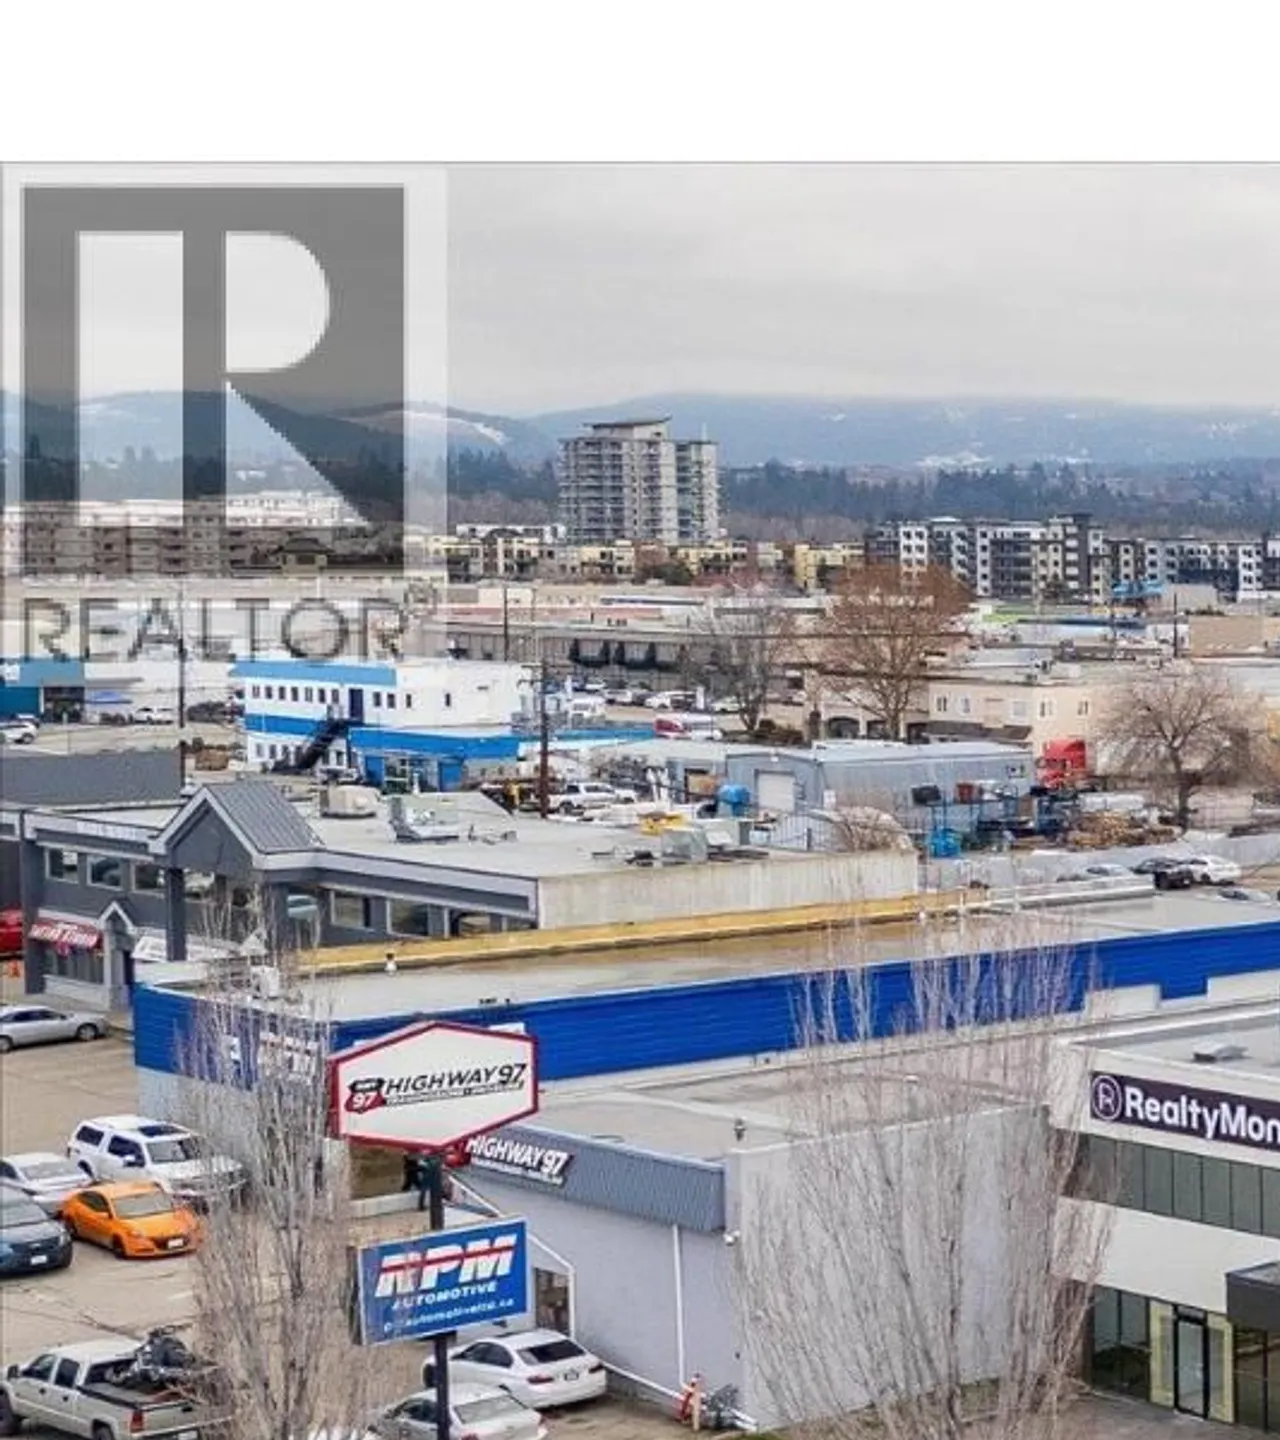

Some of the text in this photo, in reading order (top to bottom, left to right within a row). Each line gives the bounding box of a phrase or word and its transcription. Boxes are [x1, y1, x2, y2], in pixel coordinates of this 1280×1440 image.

[386, 1065, 498, 1095] HIGHWAY
[498, 1062, 527, 1086] 97
[352, 1091, 374, 1108] 97
[465, 1135, 544, 1169] HIGHWAY
[541, 1148, 569, 1176] 97
